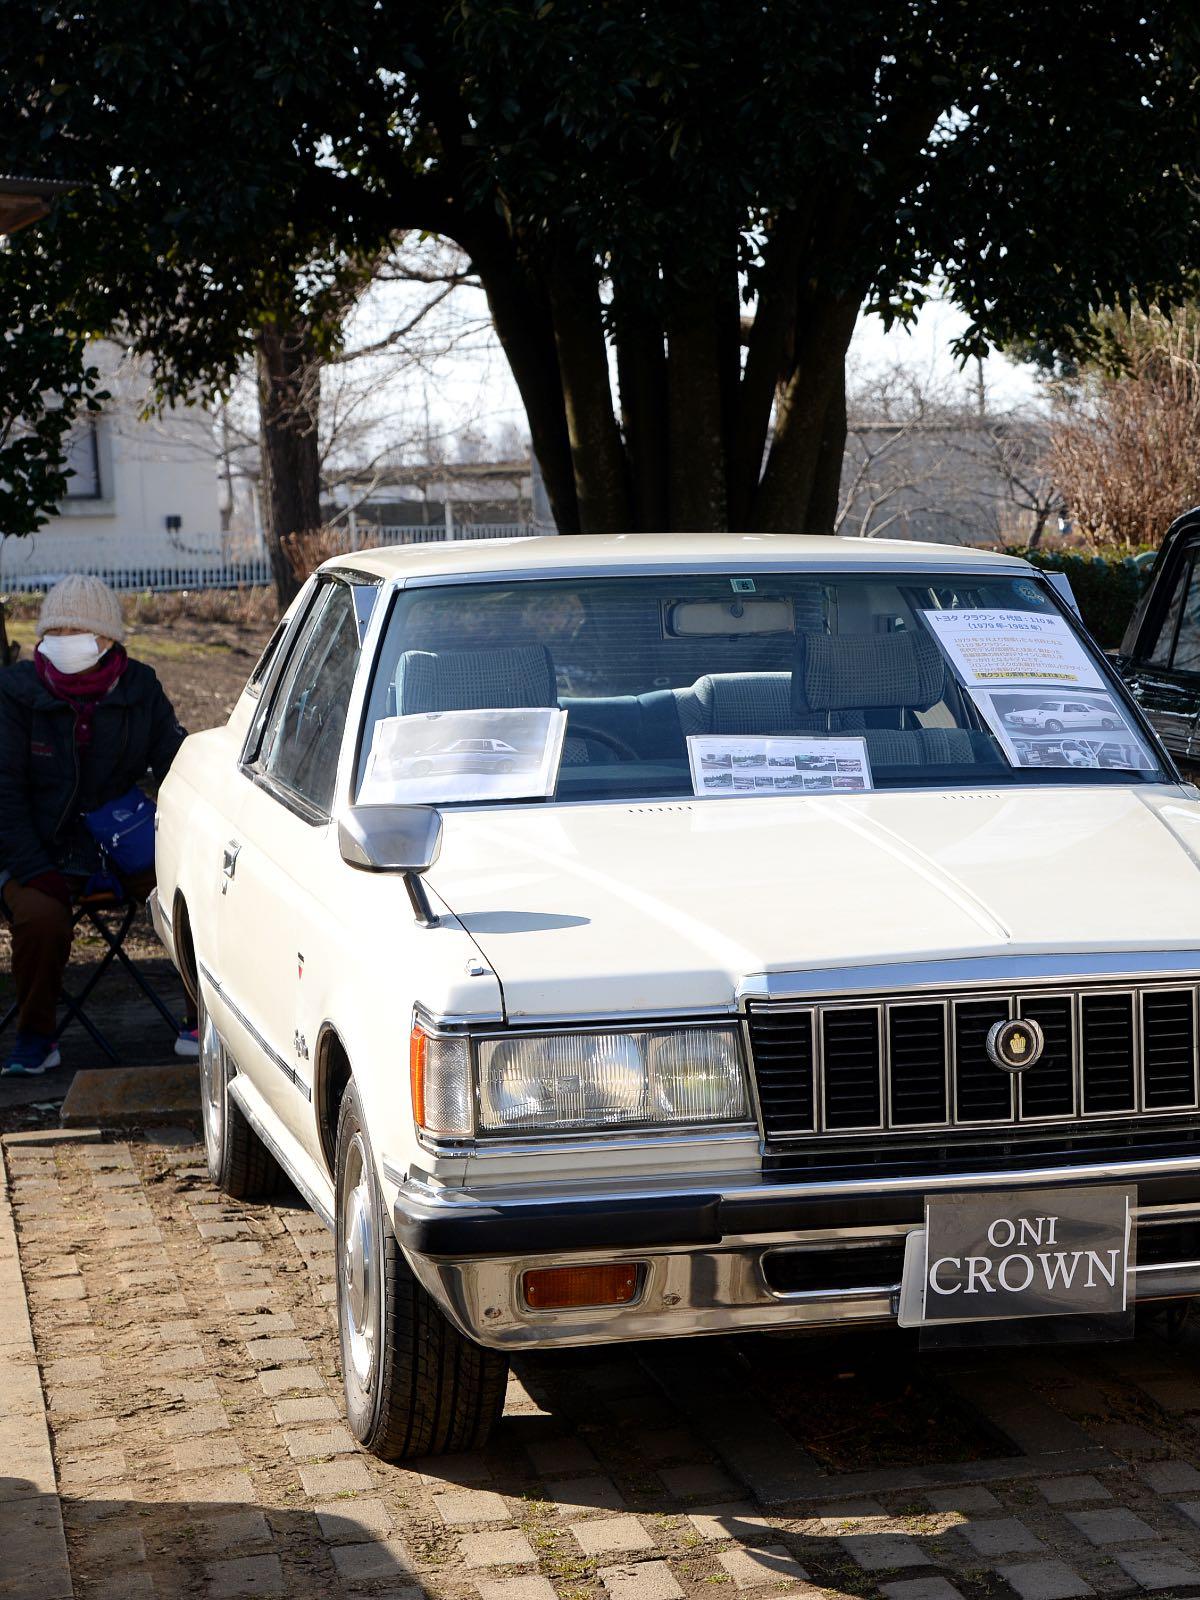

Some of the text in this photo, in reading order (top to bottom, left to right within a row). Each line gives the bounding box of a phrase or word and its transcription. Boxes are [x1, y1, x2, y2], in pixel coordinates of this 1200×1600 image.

[935, 614, 958, 622] トヨタ
[963, 613, 995, 621] クラウン
[987, 1216, 1059, 1248] ONI
[929, 1249, 1121, 1296] CROWN
